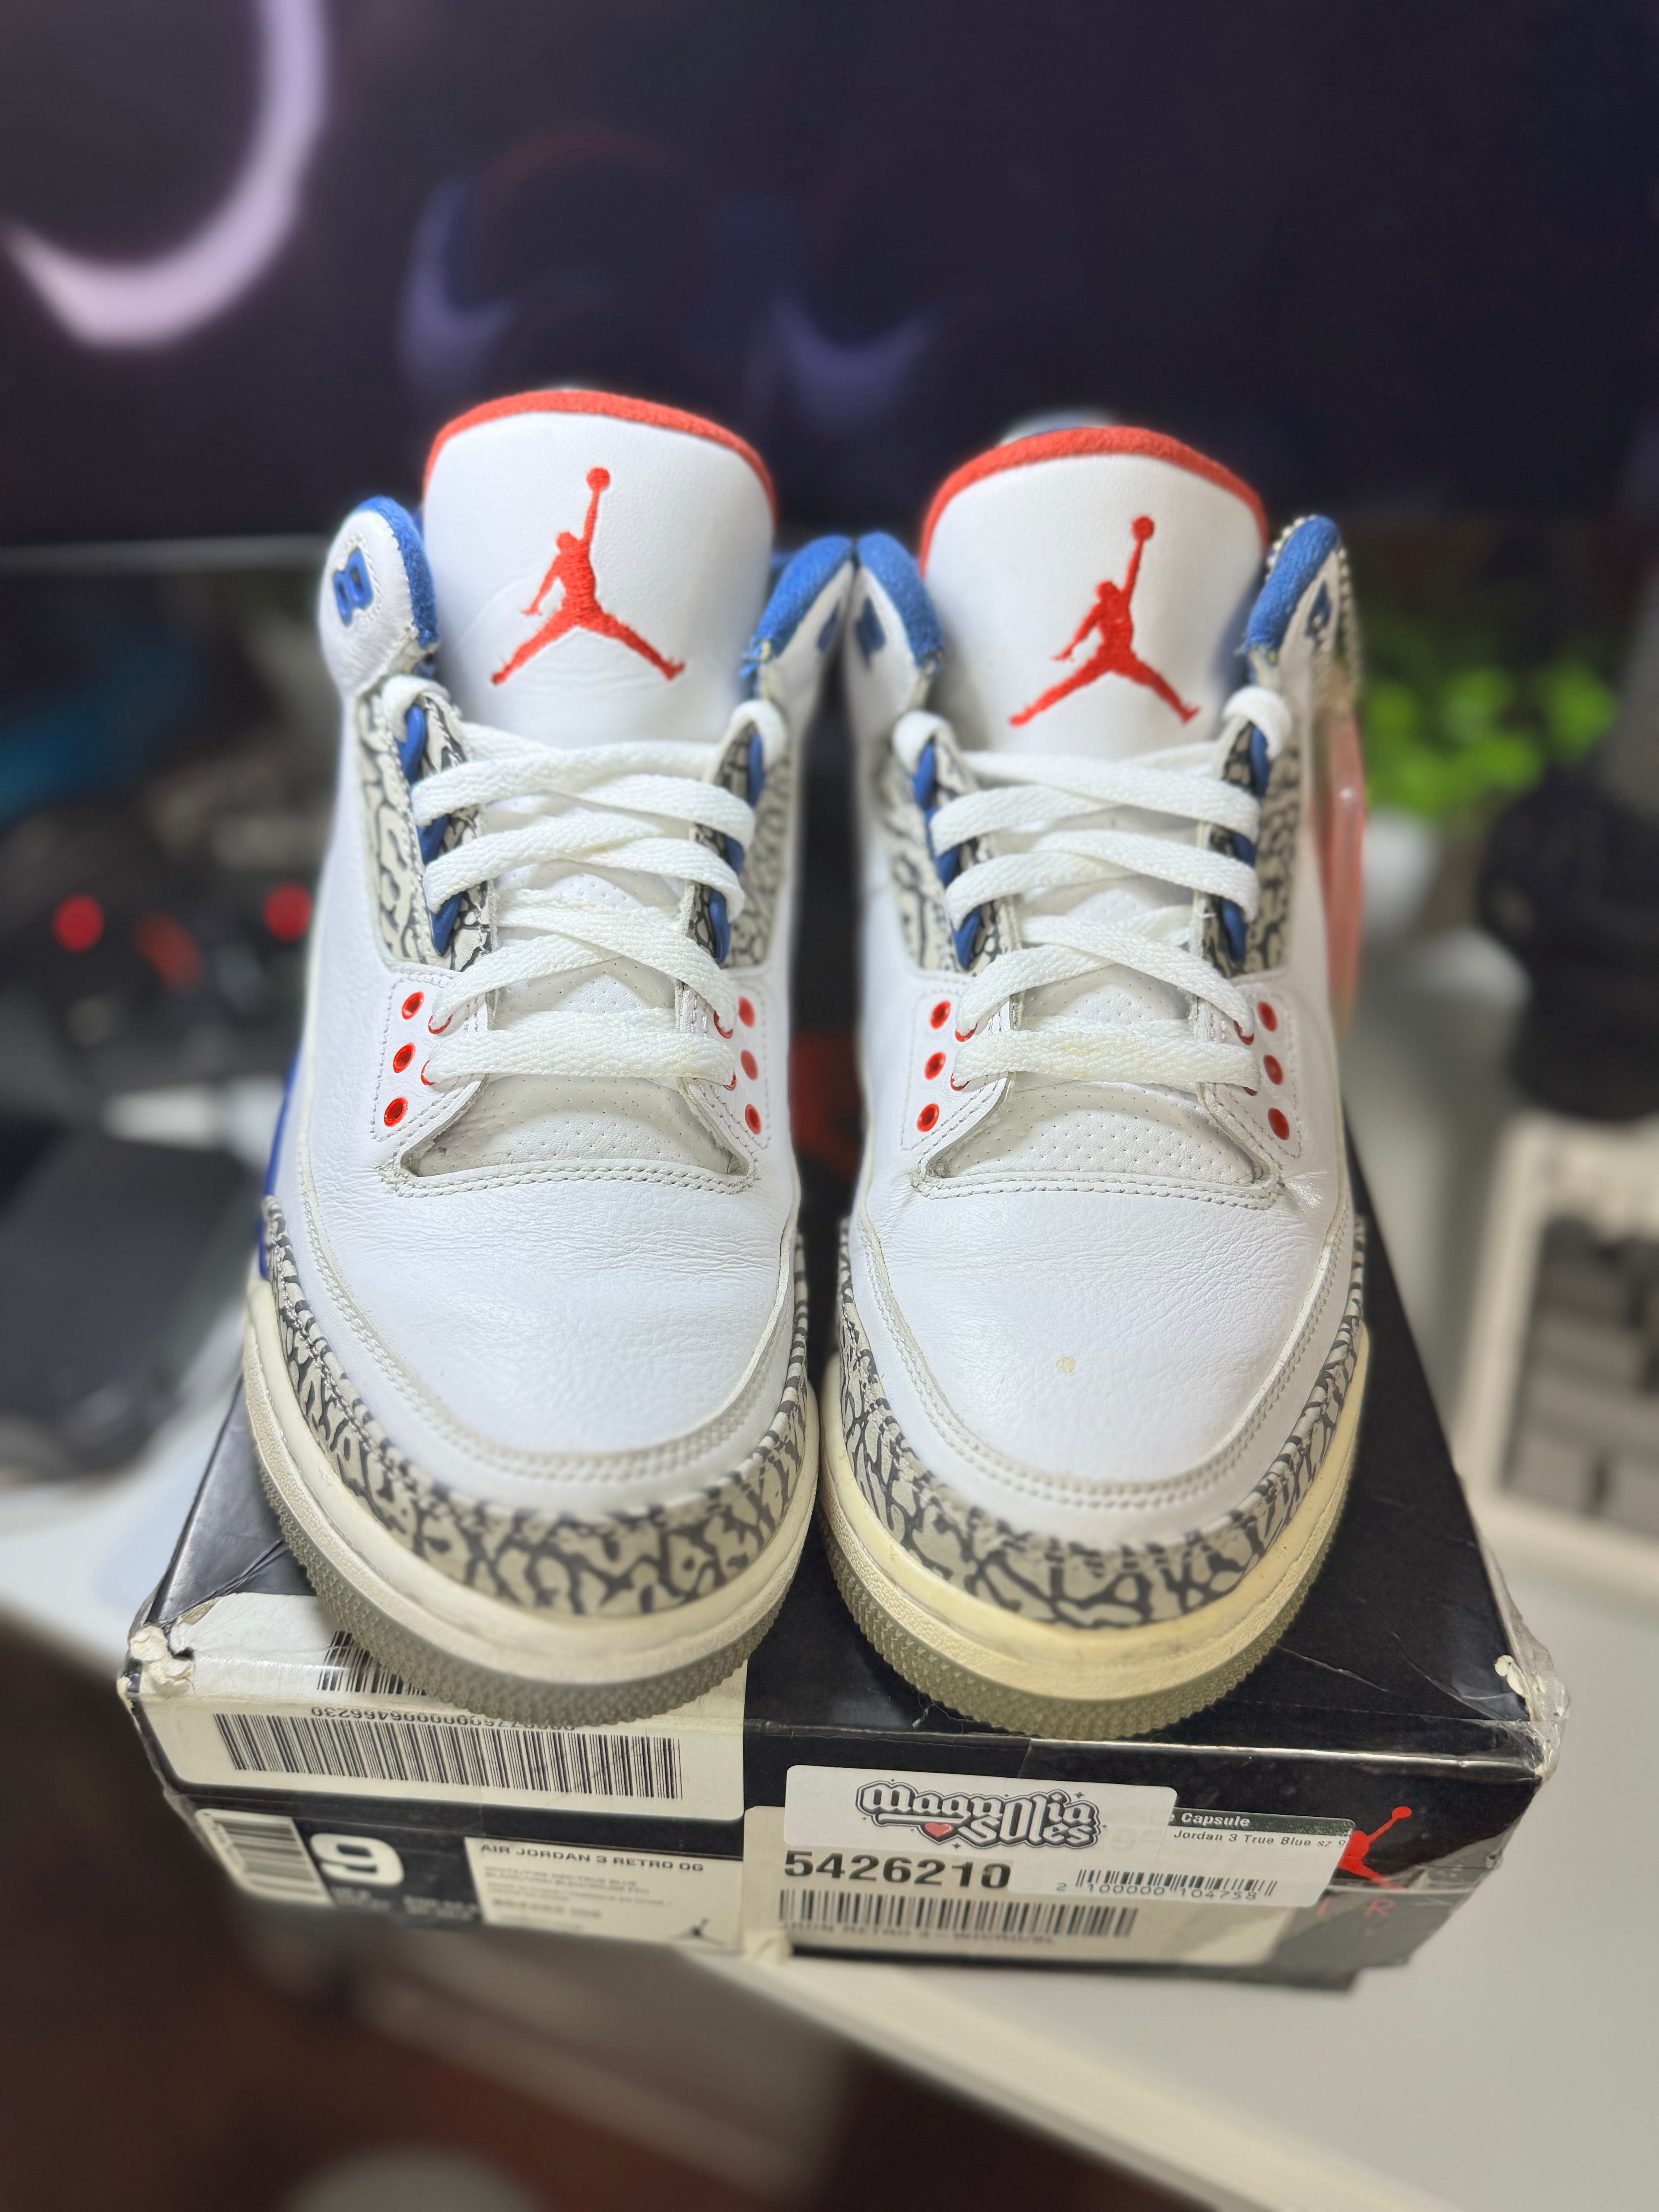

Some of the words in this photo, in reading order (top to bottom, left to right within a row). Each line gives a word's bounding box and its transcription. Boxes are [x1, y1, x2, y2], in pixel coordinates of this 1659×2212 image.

[1181, 1812, 1250, 1826] Capsule
[1173, 1829, 1223, 1841] Jordan
[1229, 1833, 1238, 1842] 3
[1243, 1834, 1274, 1844] True
[1280, 1836, 1311, 1847] Blue
[310, 1833, 404, 1887] 9
[480, 1844, 511, 1854] AIR
[516, 1848, 591, 1862] JORDAN
[596, 1855, 608, 1864] 3
[613, 1856, 674, 1869] RETRO
[679, 1862, 704, 1872] OG
[783, 1850, 1011, 1888] 5426210
[1056, 1882, 1067, 1892] 2
[1087, 1883, 1166, 1896] 100000
[1179, 1888, 1257, 1900] 104758
